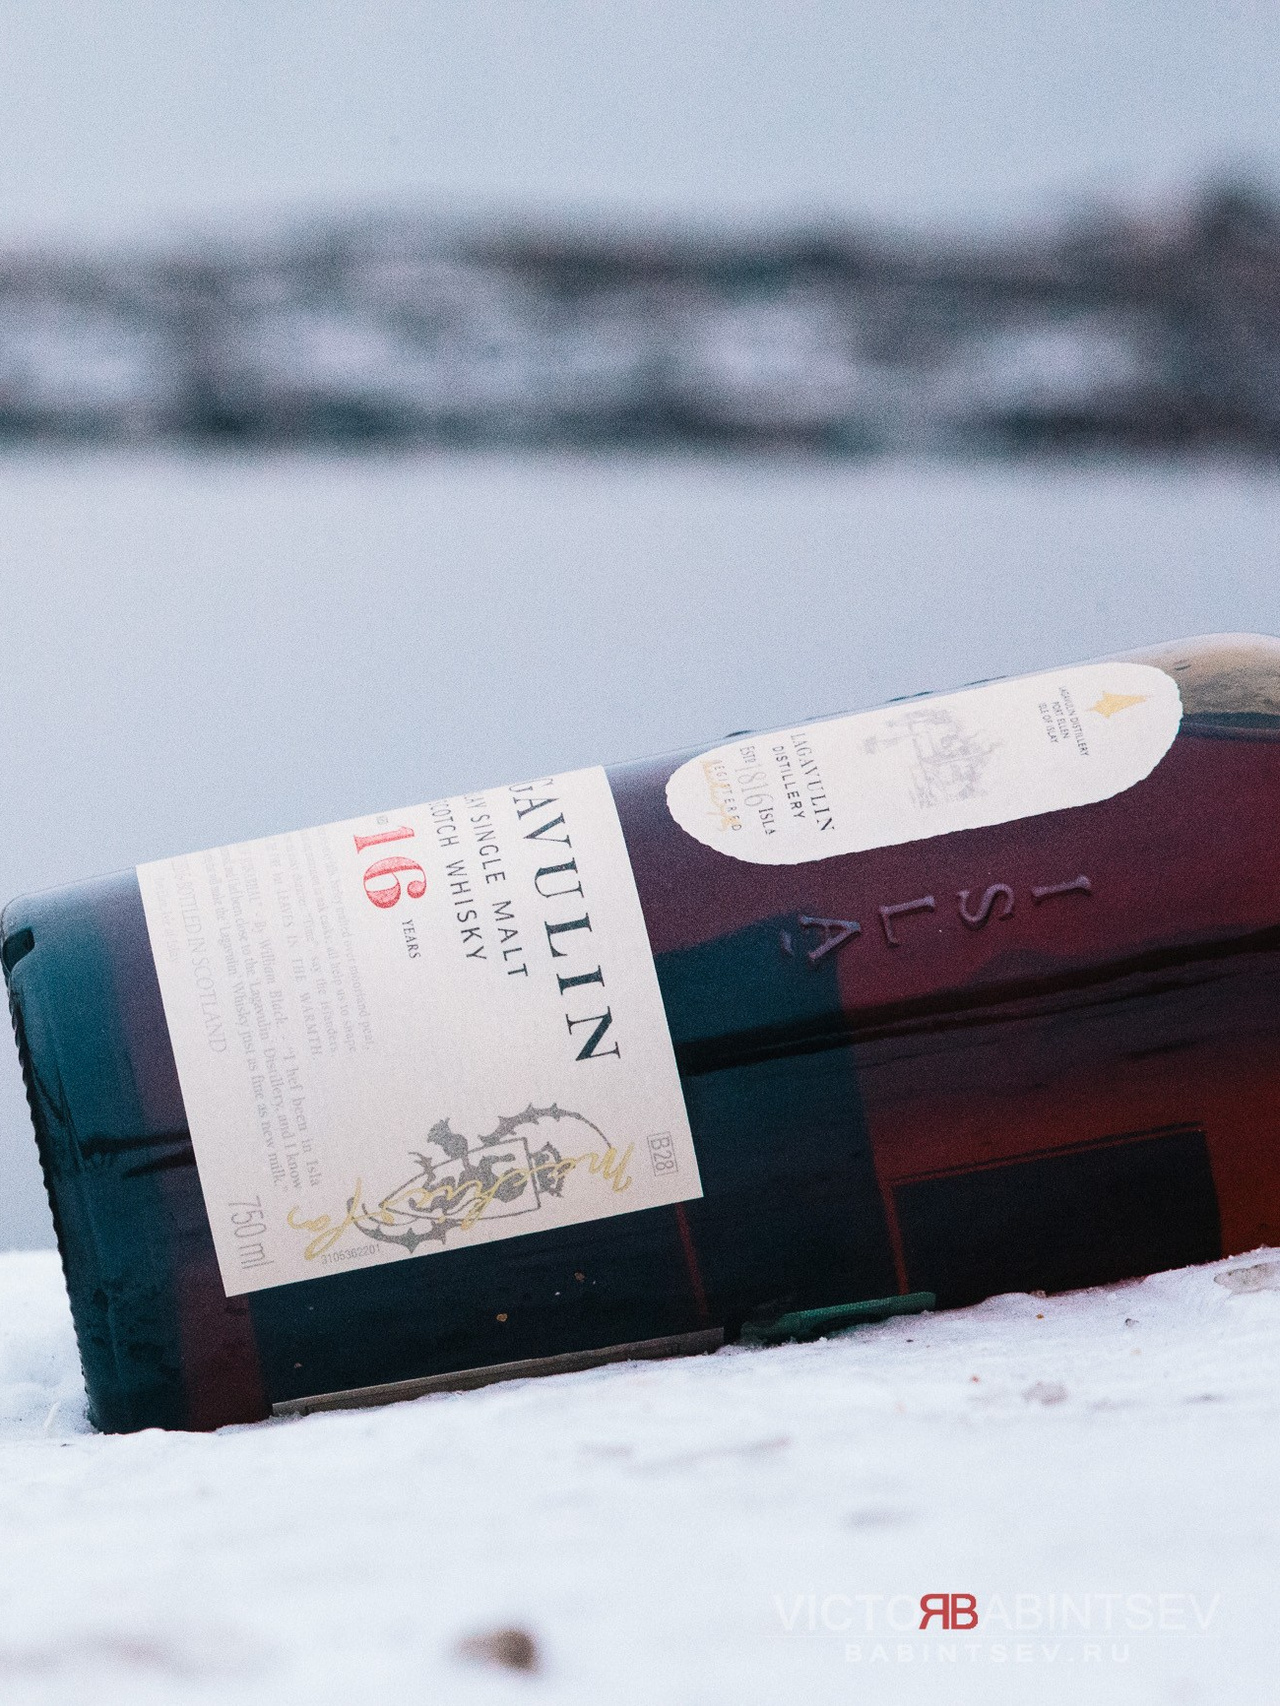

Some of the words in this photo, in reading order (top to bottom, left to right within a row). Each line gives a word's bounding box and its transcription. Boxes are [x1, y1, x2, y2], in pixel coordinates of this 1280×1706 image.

[734, 764, 774, 806] 1816
[758, 807, 776, 835] ISLA
[772, 746, 806, 818] DISTILLERY
[790, 733, 835, 831] LAGAVULIN
[351, 821, 432, 913] 16
[399, 918, 421, 960] YEARS
[443, 860, 488, 965] WHISKY
[469, 813, 506, 885] SINGLE
[490, 899, 529, 981] MALT
[186, 935, 207, 954] IN
[256, 938, 279, 985] William
[290, 957, 306, 983] THE
[190, 956, 228, 1055] SCOTLAND
[226, 980, 252, 1029] Whisky
[237, 1028, 257, 1056] just
[339, 1019, 359, 1053] shape
[249, 1074, 268, 1100] fine
[259, 1120, 276, 1149] new
[290, 1095, 312, 1132] been
[276, 1113, 294, 1140] and
[285, 1152, 306, 1190] know
[300, 1137, 315, 1153] in
[304, 1159, 323, 1187] Isla
[225, 1194, 268, 1241] 750
[235, 1239, 275, 1271] ml
